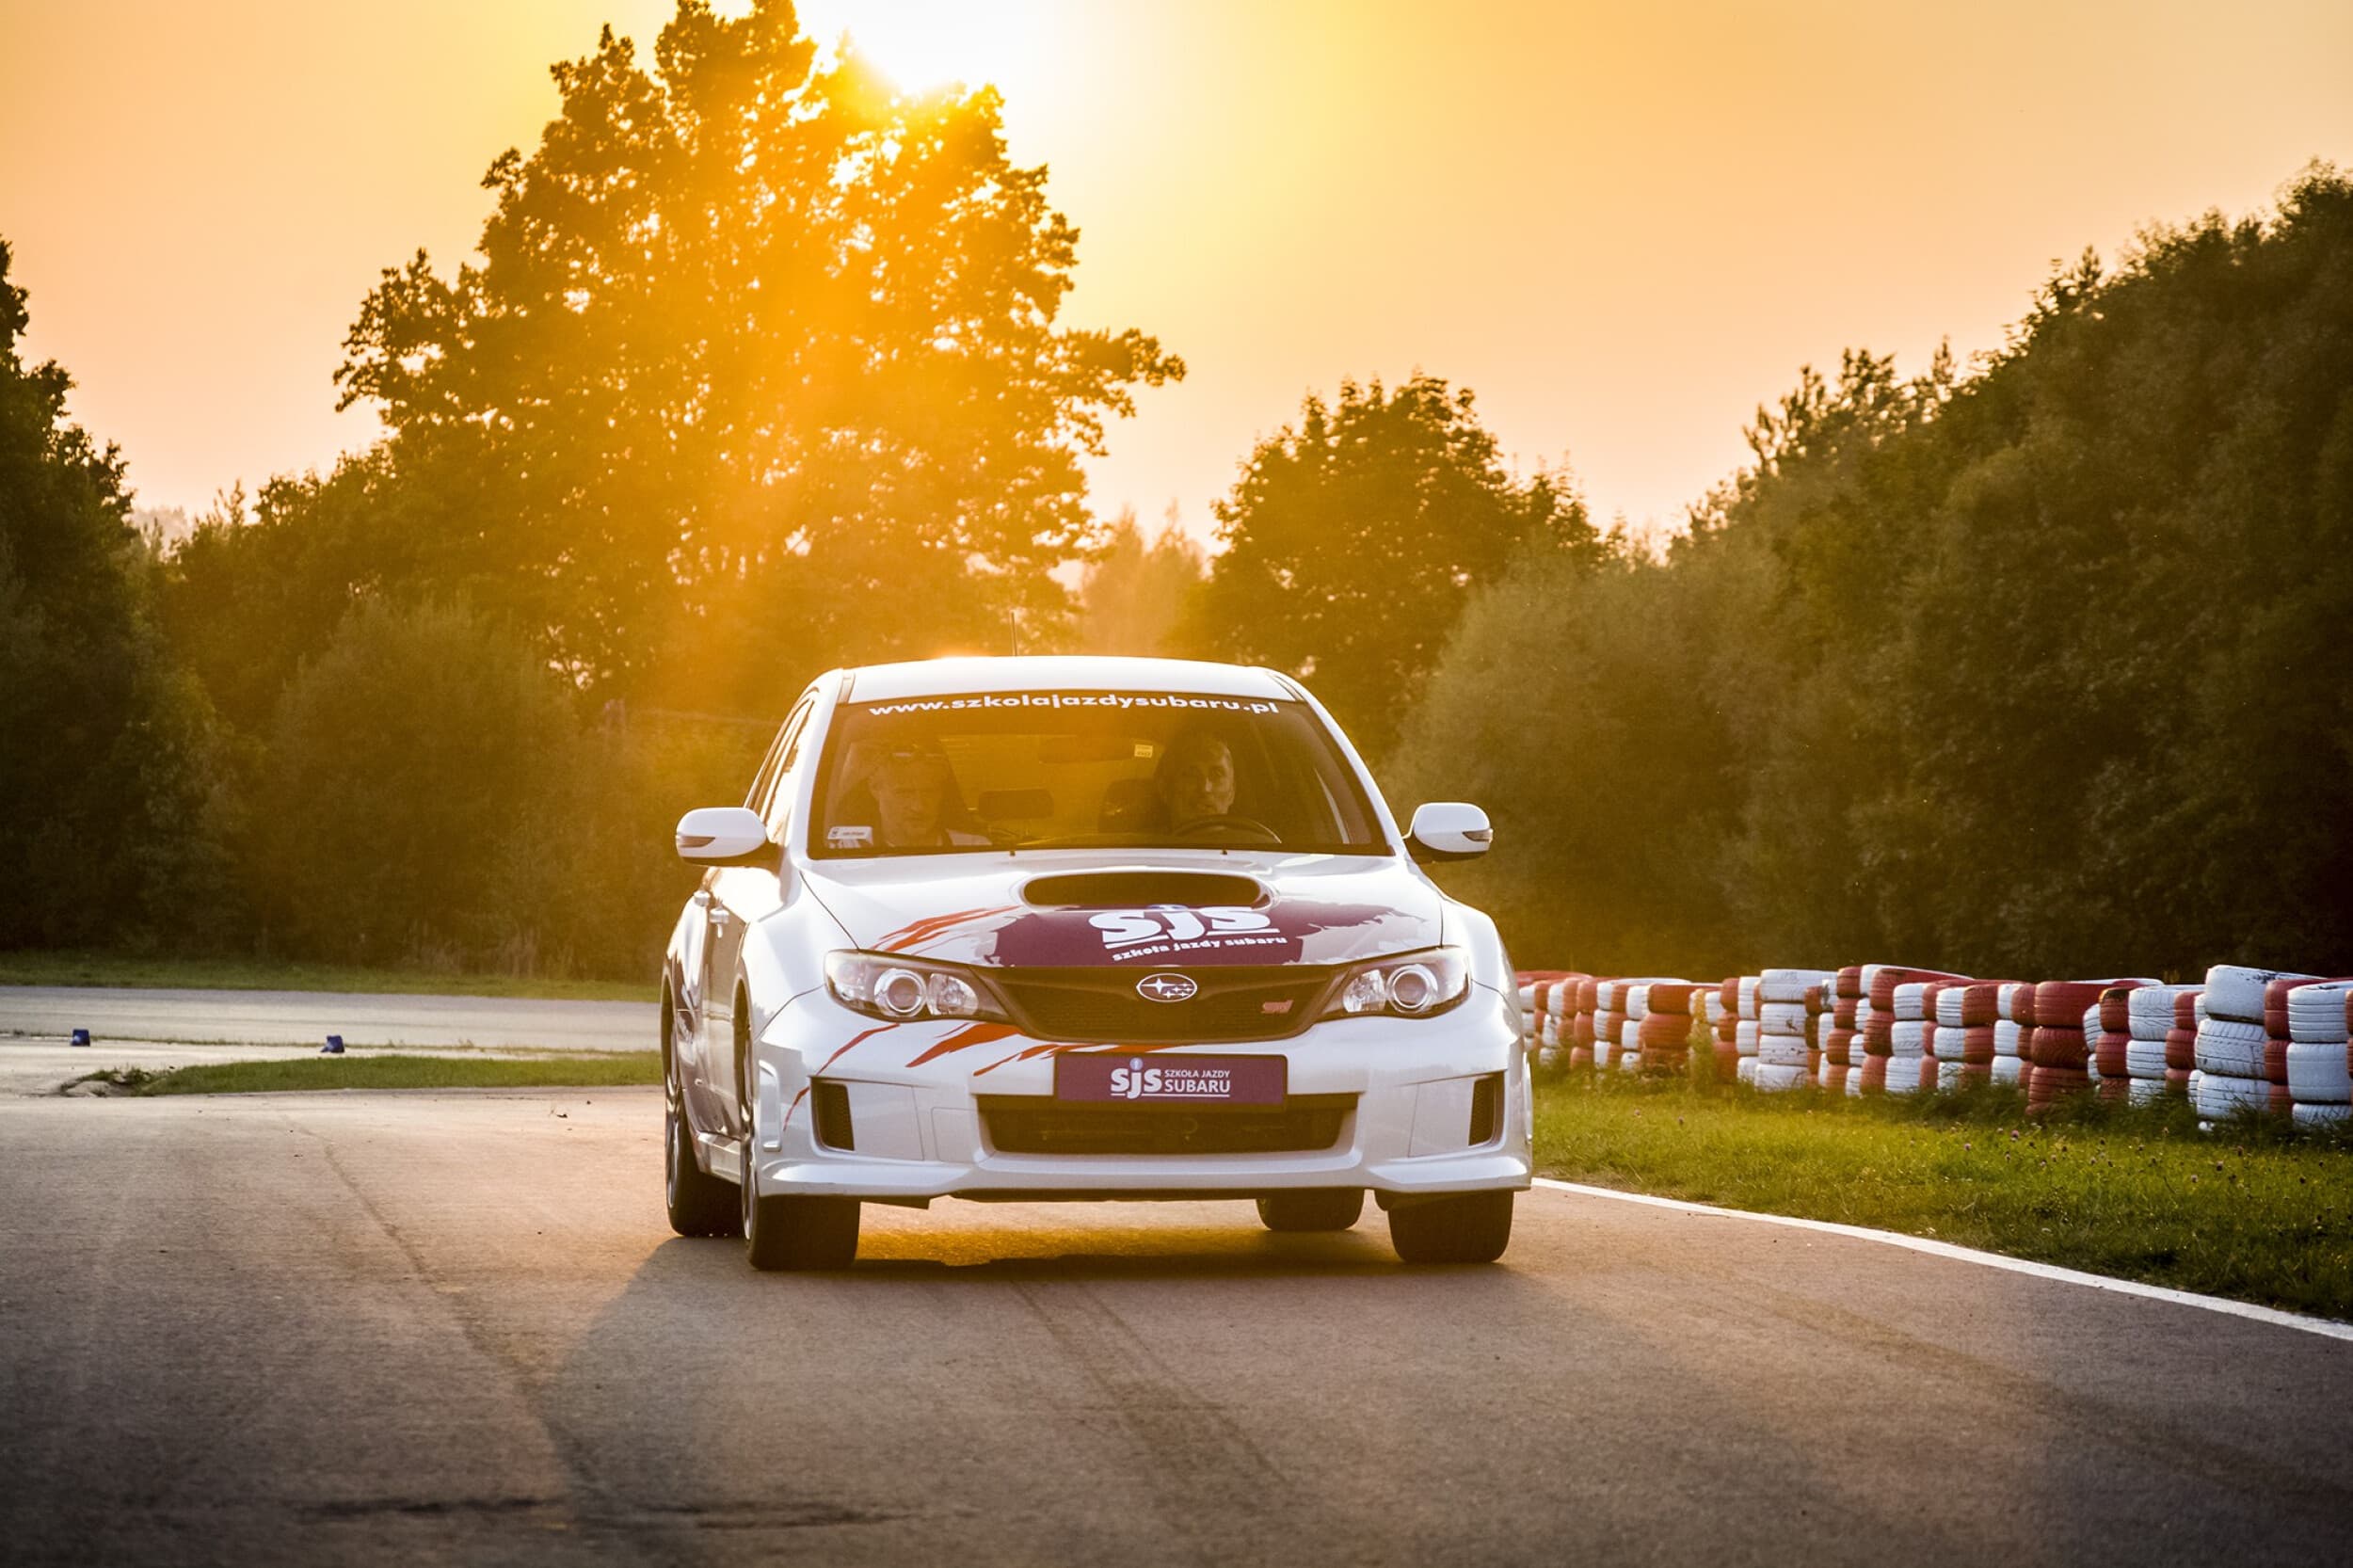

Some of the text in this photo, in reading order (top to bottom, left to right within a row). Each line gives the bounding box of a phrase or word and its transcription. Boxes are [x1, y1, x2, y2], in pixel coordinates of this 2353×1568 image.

[869, 694, 1280, 715] www.szkolajazdysubaru.pl
[1174, 939, 1221, 952] jazdy
[1225, 936, 1288, 947] subaru
[1164, 1069, 1230, 1079] SZKOŁA JAZDY
[1164, 1079, 1230, 1093] SUBARU
